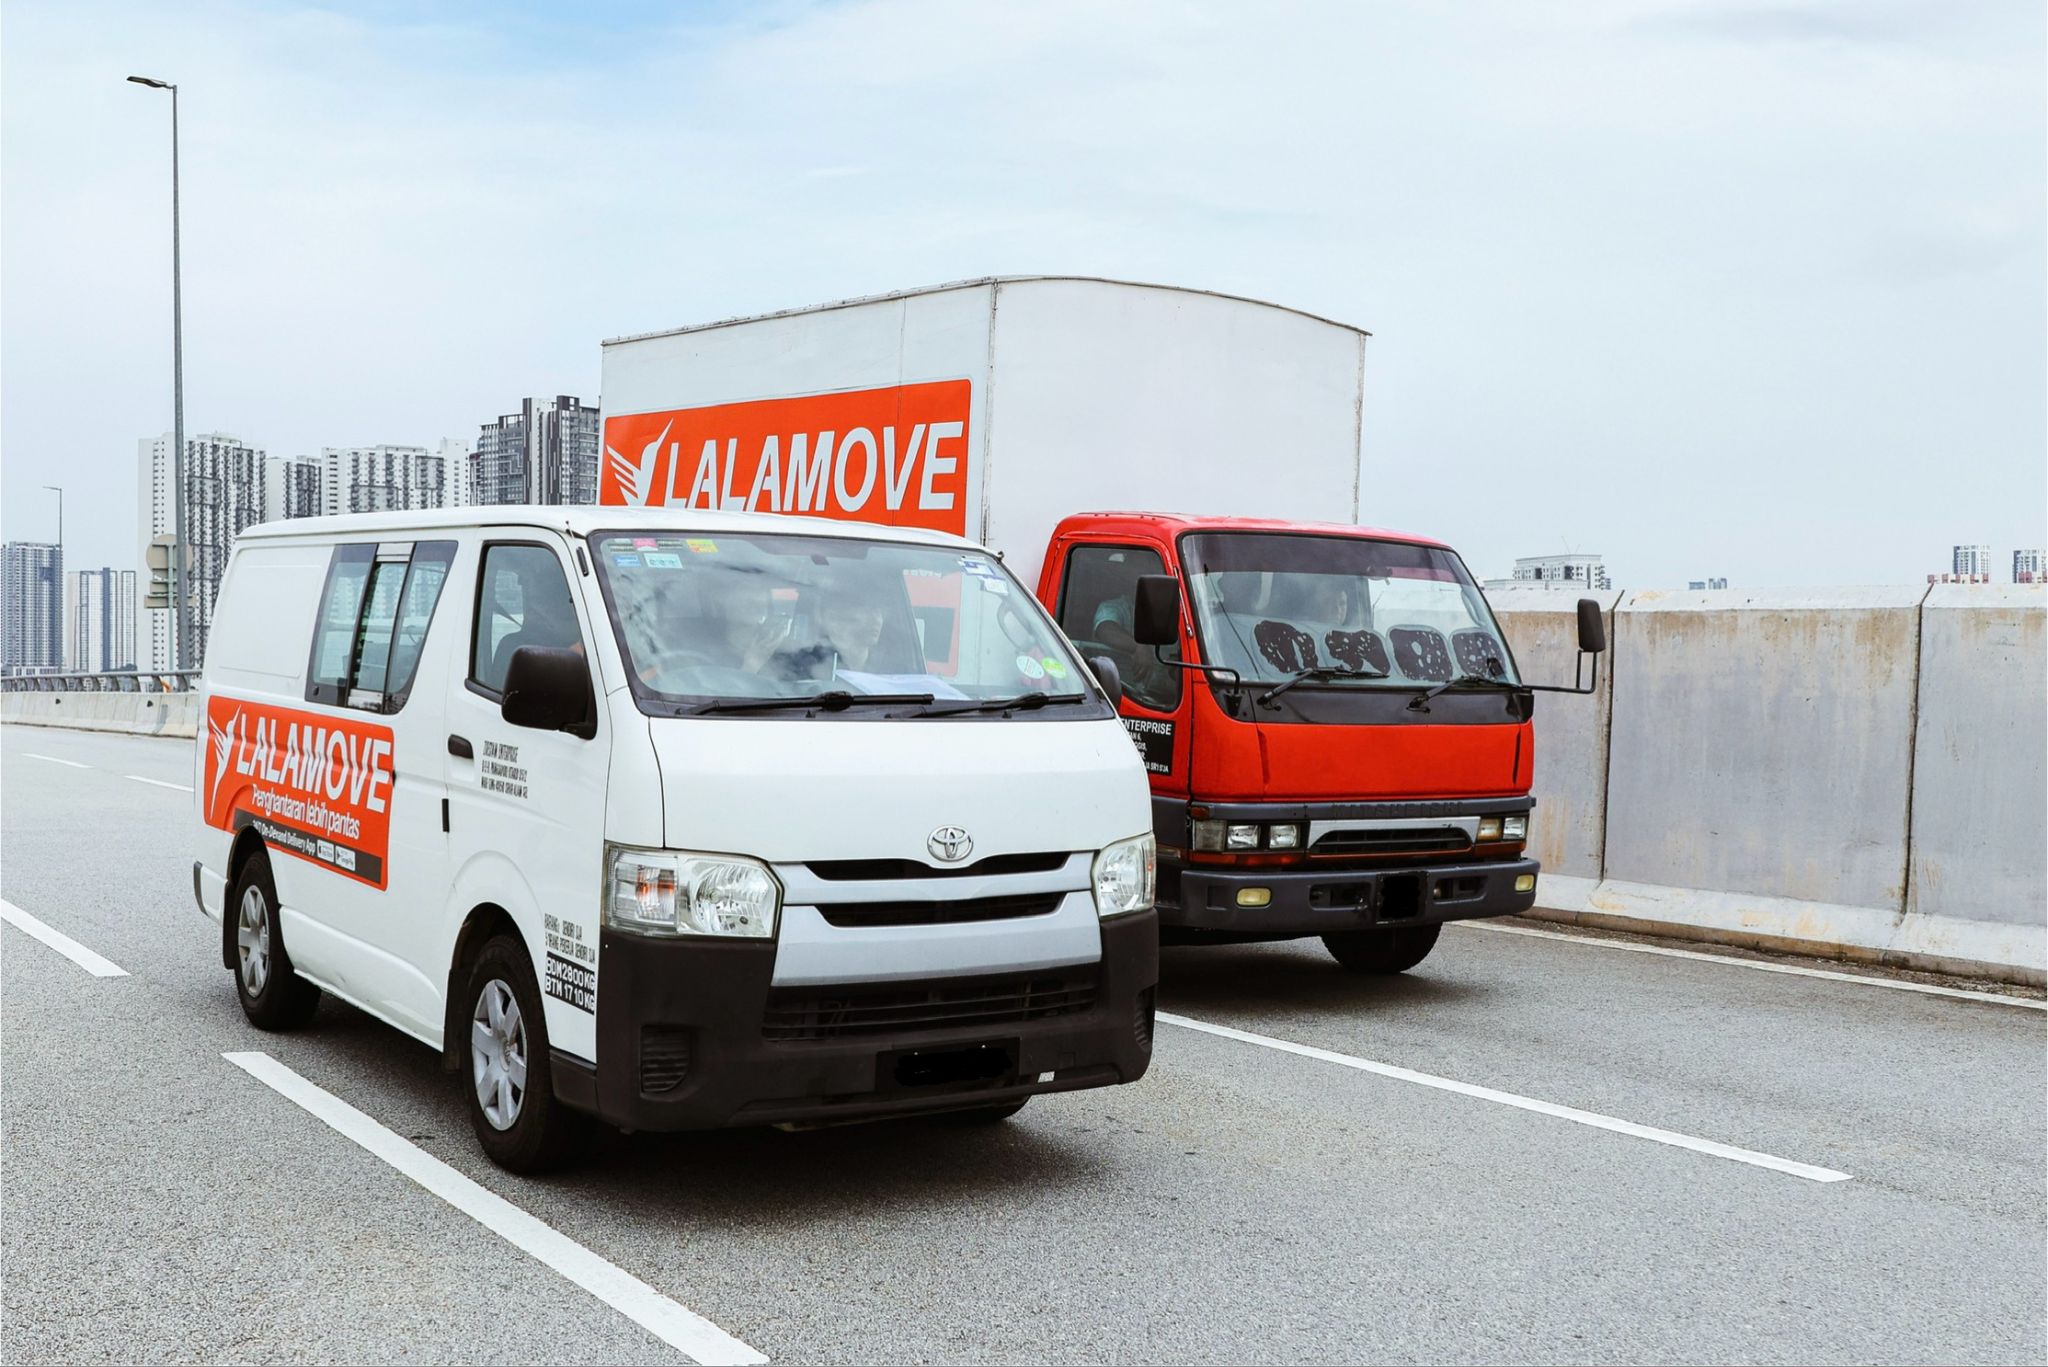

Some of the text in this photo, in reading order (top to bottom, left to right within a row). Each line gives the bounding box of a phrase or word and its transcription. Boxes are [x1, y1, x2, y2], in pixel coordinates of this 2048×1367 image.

[665, 421, 964, 513] LALAMOVE
[236, 713, 391, 813] LALAMOVE
[252, 783, 360, 840] Penghantaran lebih pantas
[545, 975, 562, 997] BTM
